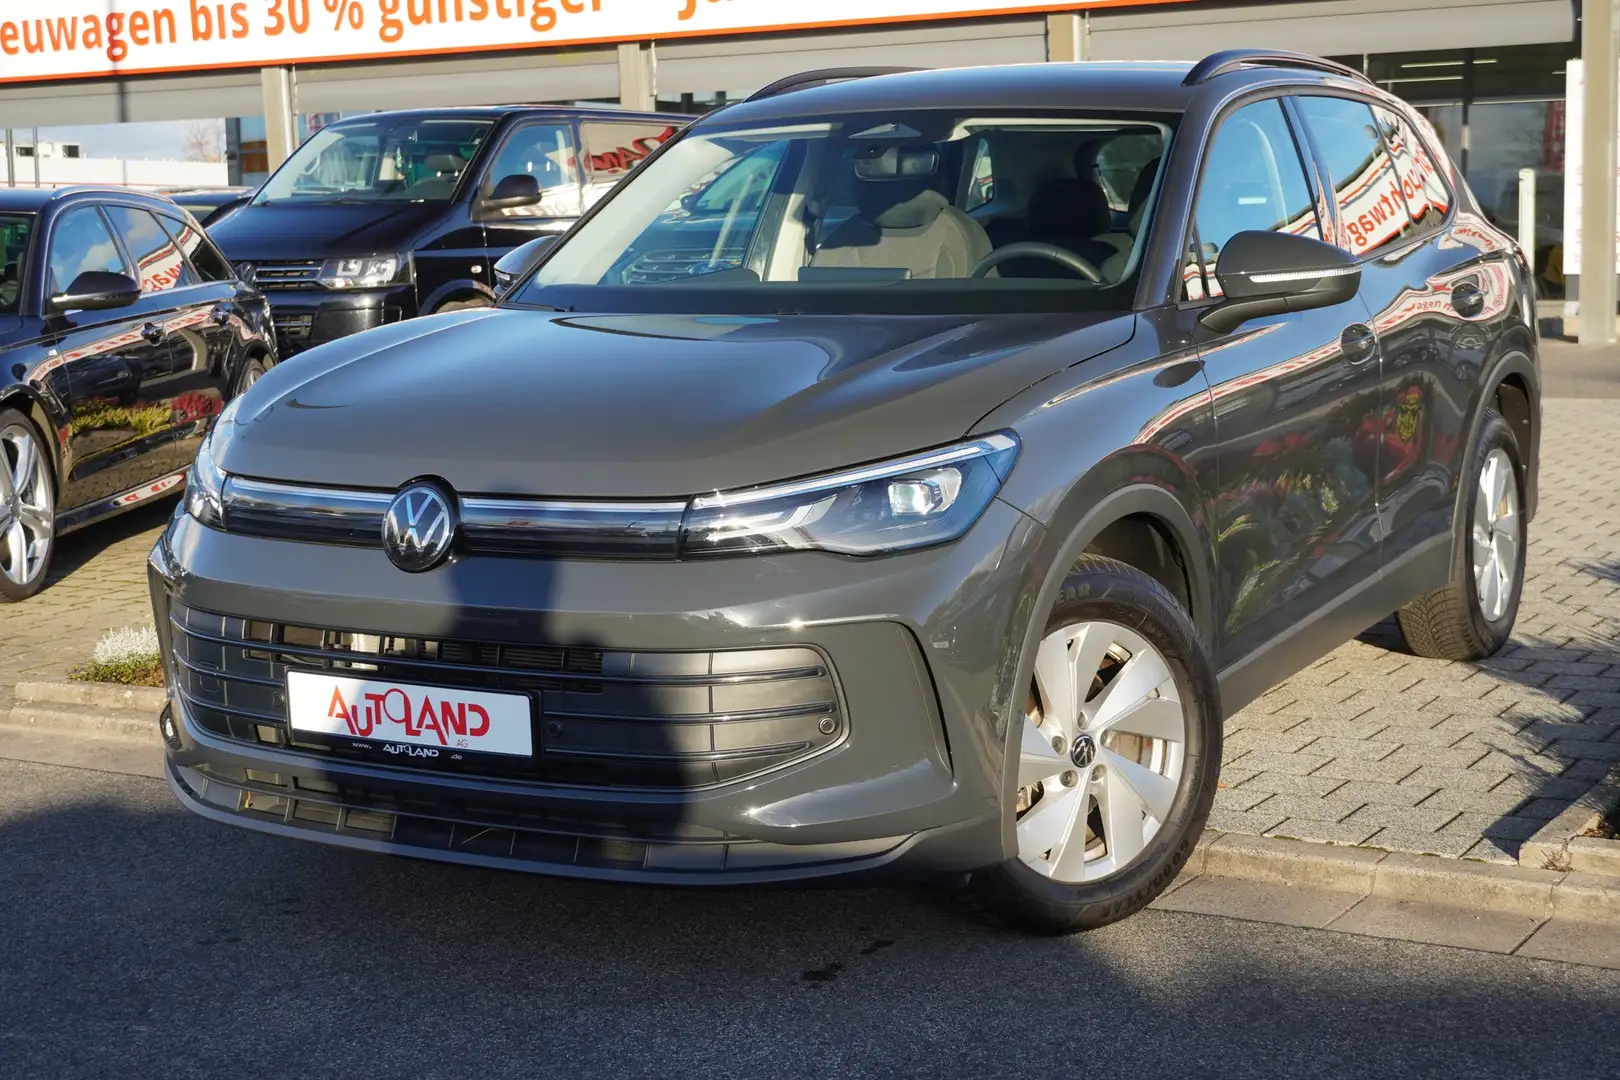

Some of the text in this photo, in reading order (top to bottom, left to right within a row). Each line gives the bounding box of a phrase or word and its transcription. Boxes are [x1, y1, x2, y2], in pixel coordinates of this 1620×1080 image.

[0, 8, 177, 62] euwagen
[189, 0, 250, 42] bis
[264, 0, 310, 36] 30
[327, 684, 491, 746] AUTOLAND
[456, 739, 469, 748] AG
